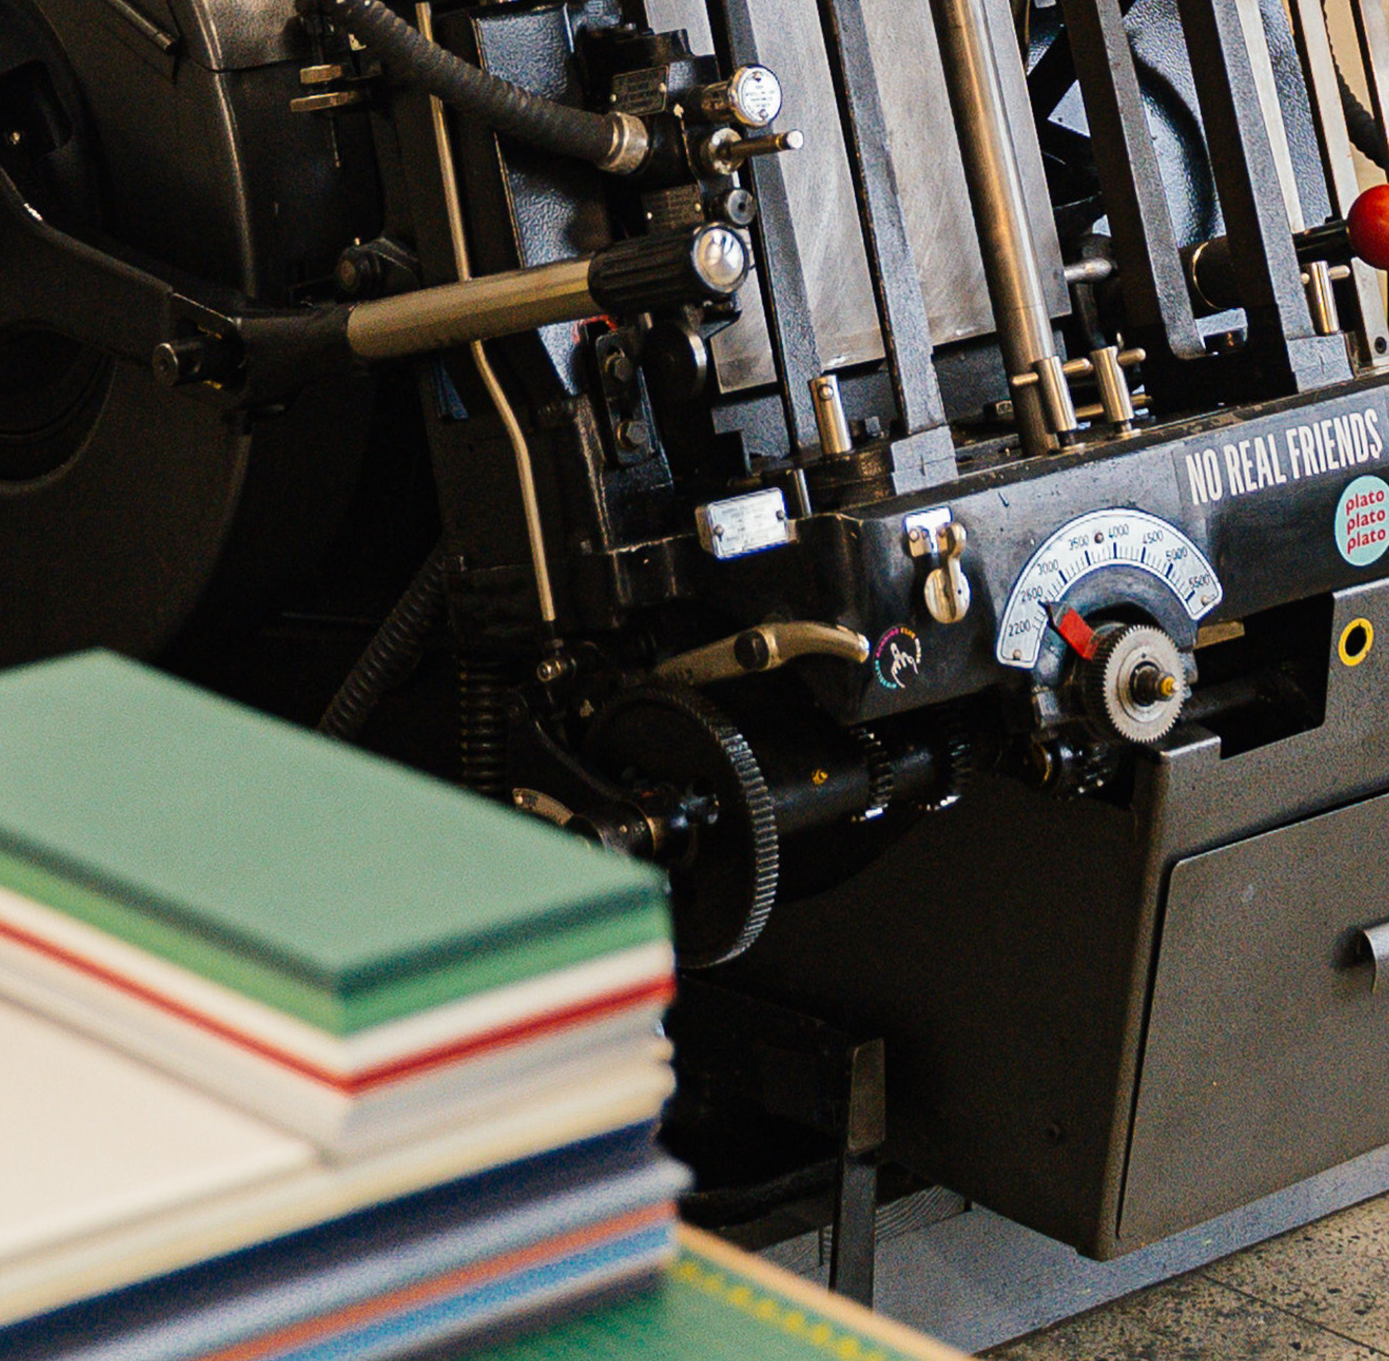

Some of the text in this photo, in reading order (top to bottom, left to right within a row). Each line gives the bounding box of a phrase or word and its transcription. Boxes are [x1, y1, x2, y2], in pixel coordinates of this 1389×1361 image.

[1186, 408, 1383, 505] NO REAL FRIENDS
[1345, 489, 1385, 515] plato
[1346, 509, 1386, 535] plato
[1346, 529, 1387, 555] plato
[1008, 619, 1031, 637] 2200
[1036, 559, 1060, 576] 3000
[1068, 534, 1090, 551] 3500
[1108, 524, 1130, 538] 4000
[1143, 530, 1165, 544] 4500
